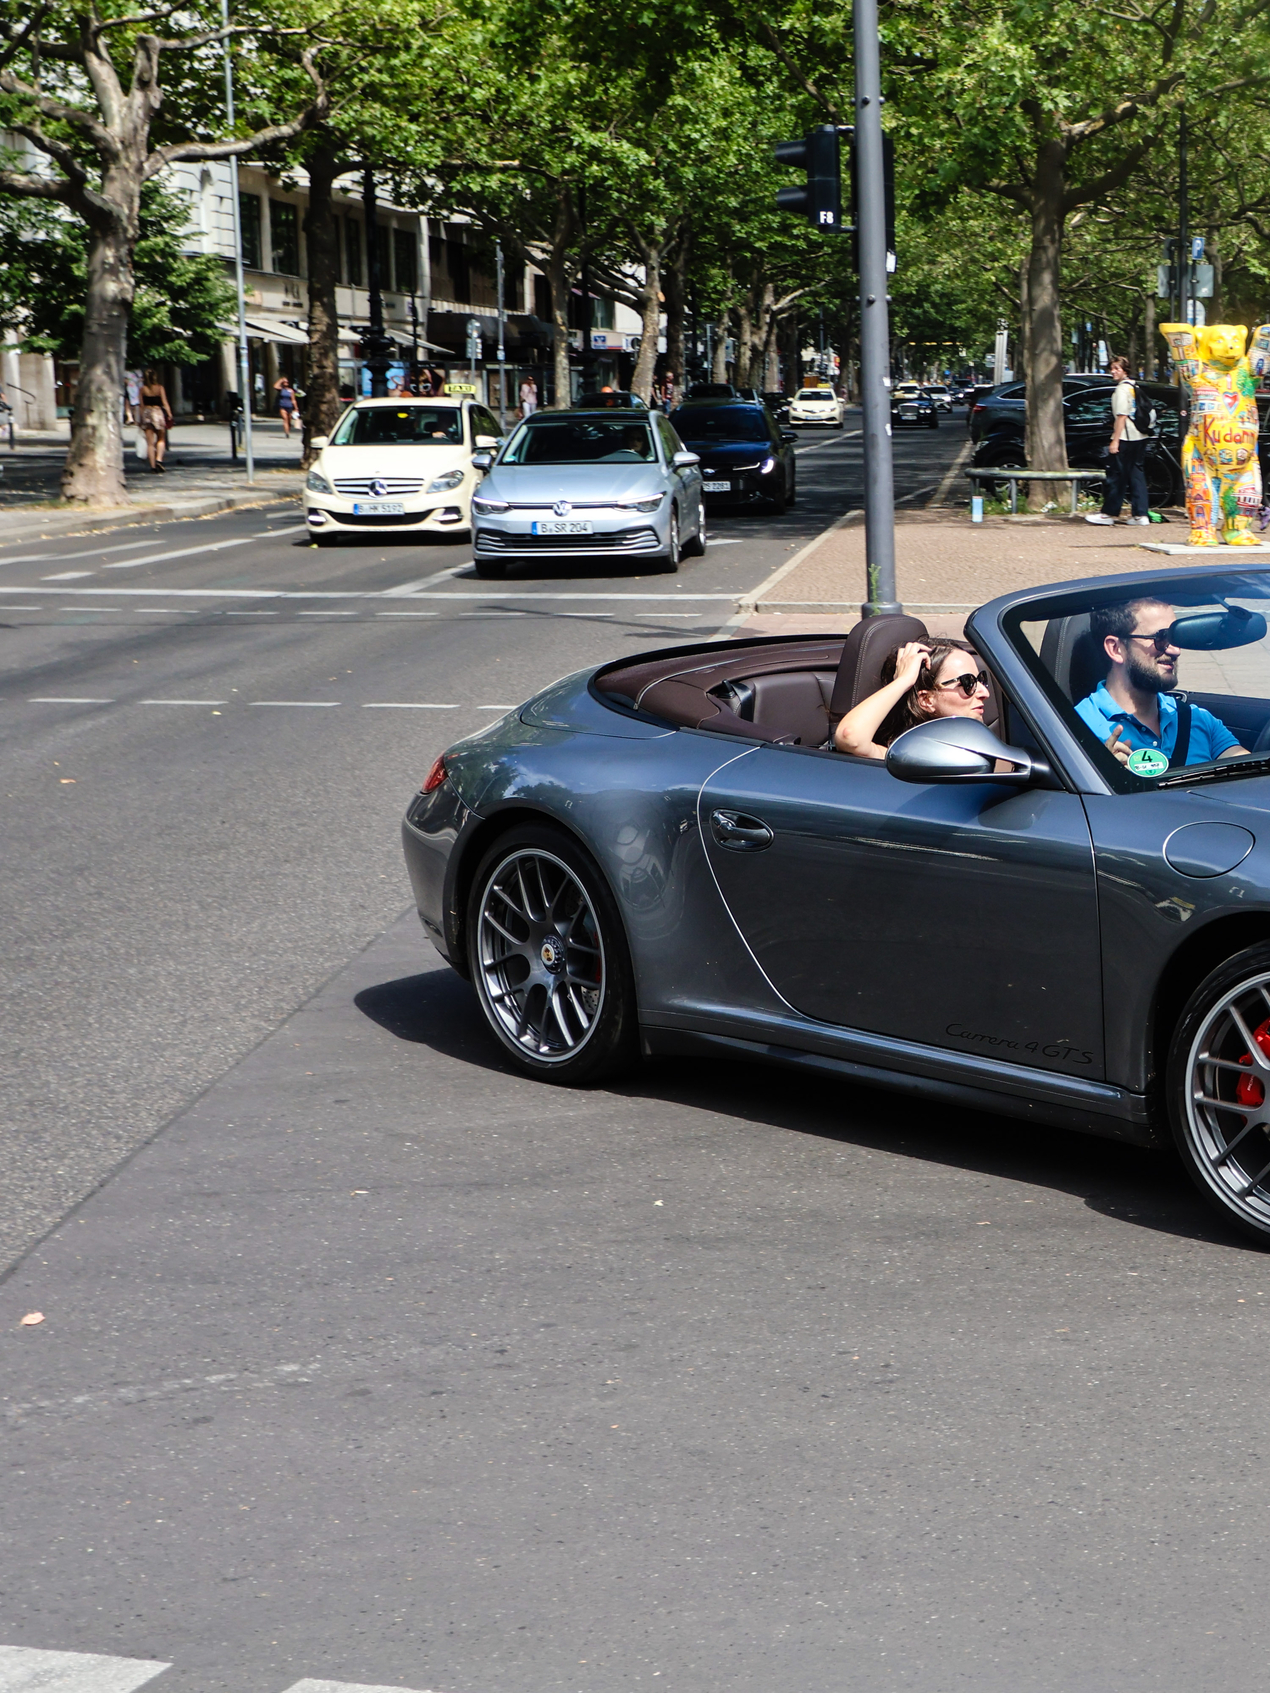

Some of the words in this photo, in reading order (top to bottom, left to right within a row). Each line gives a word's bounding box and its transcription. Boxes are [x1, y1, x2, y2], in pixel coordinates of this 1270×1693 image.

[820, 211, 834, 224] F8
[541, 523, 548, 533] B
[554, 523, 567, 533] SR
[570, 522, 588, 533] 204
[1141, 750, 1153, 763] 4
[945, 1023, 1020, 1050] Carrera
[1024, 1041, 1039, 1053] 4
[1041, 1044, 1095, 1065] GTS
